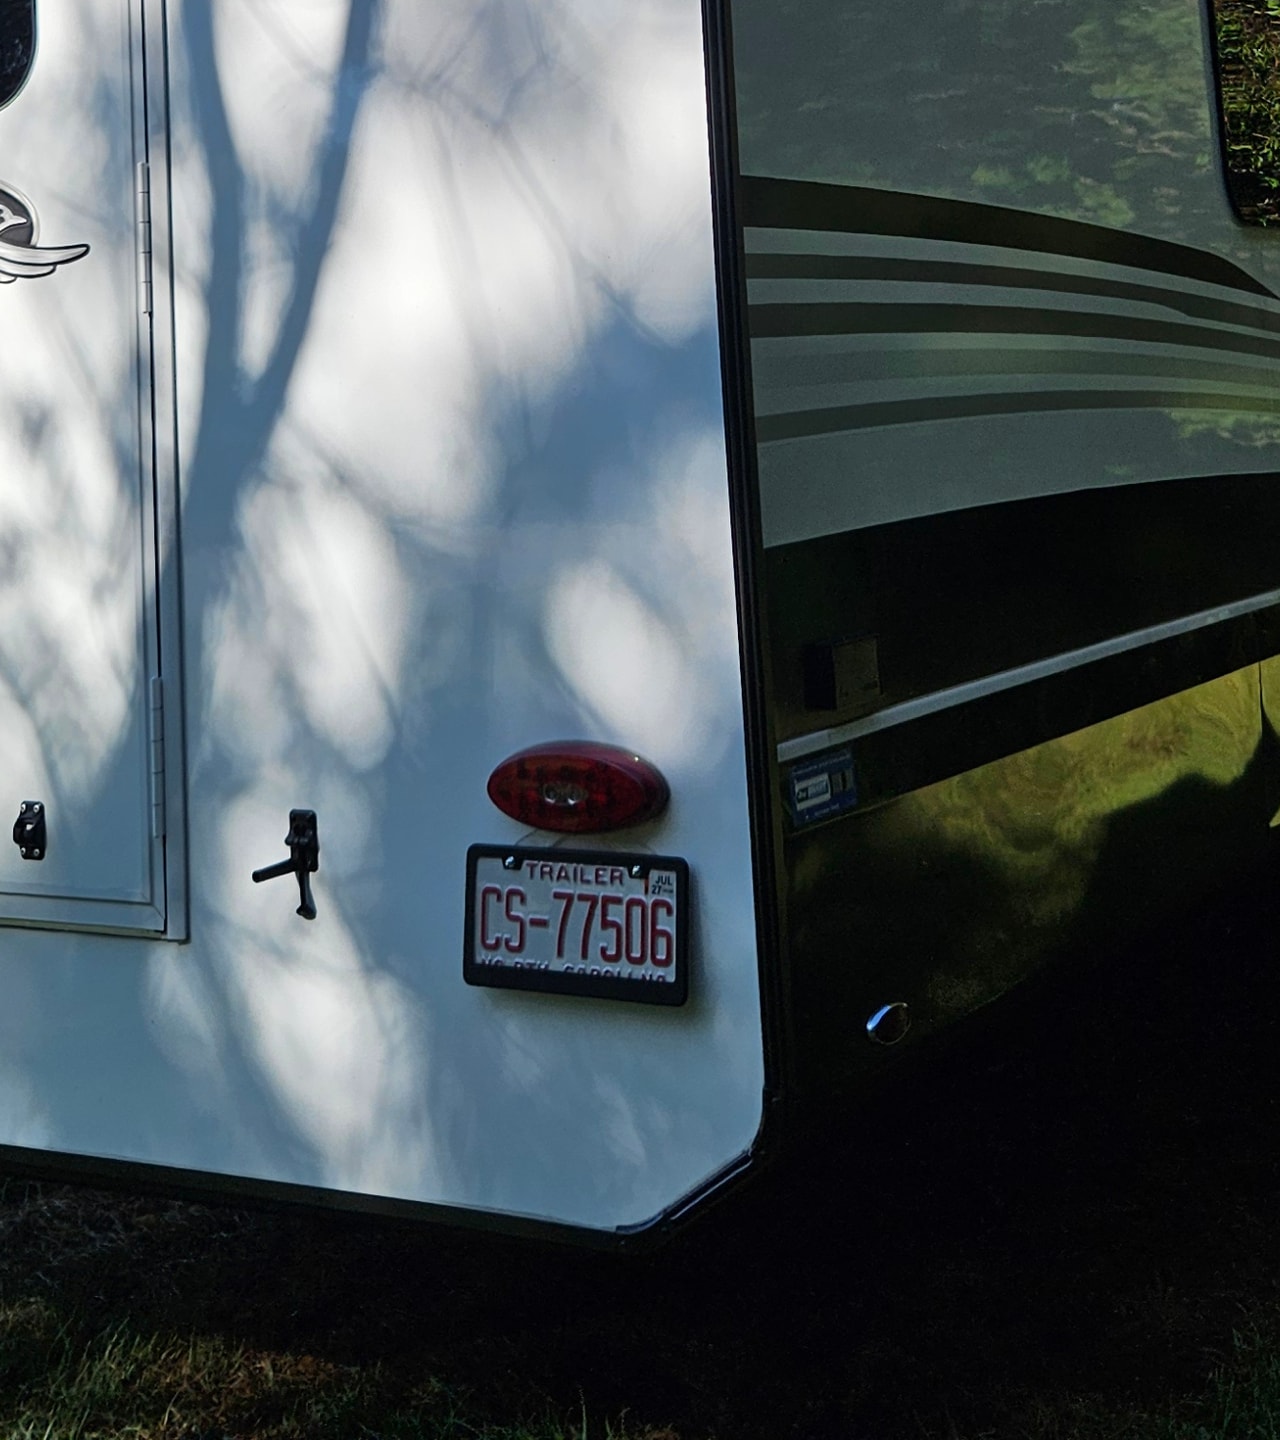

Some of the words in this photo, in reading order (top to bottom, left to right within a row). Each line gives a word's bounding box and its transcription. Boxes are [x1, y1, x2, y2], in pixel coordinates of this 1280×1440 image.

[525, 861, 625, 887] TRAILER
[655, 874, 673, 886] JUL
[651, 884, 662, 894] 27
[479, 884, 675, 969] CS-77506
